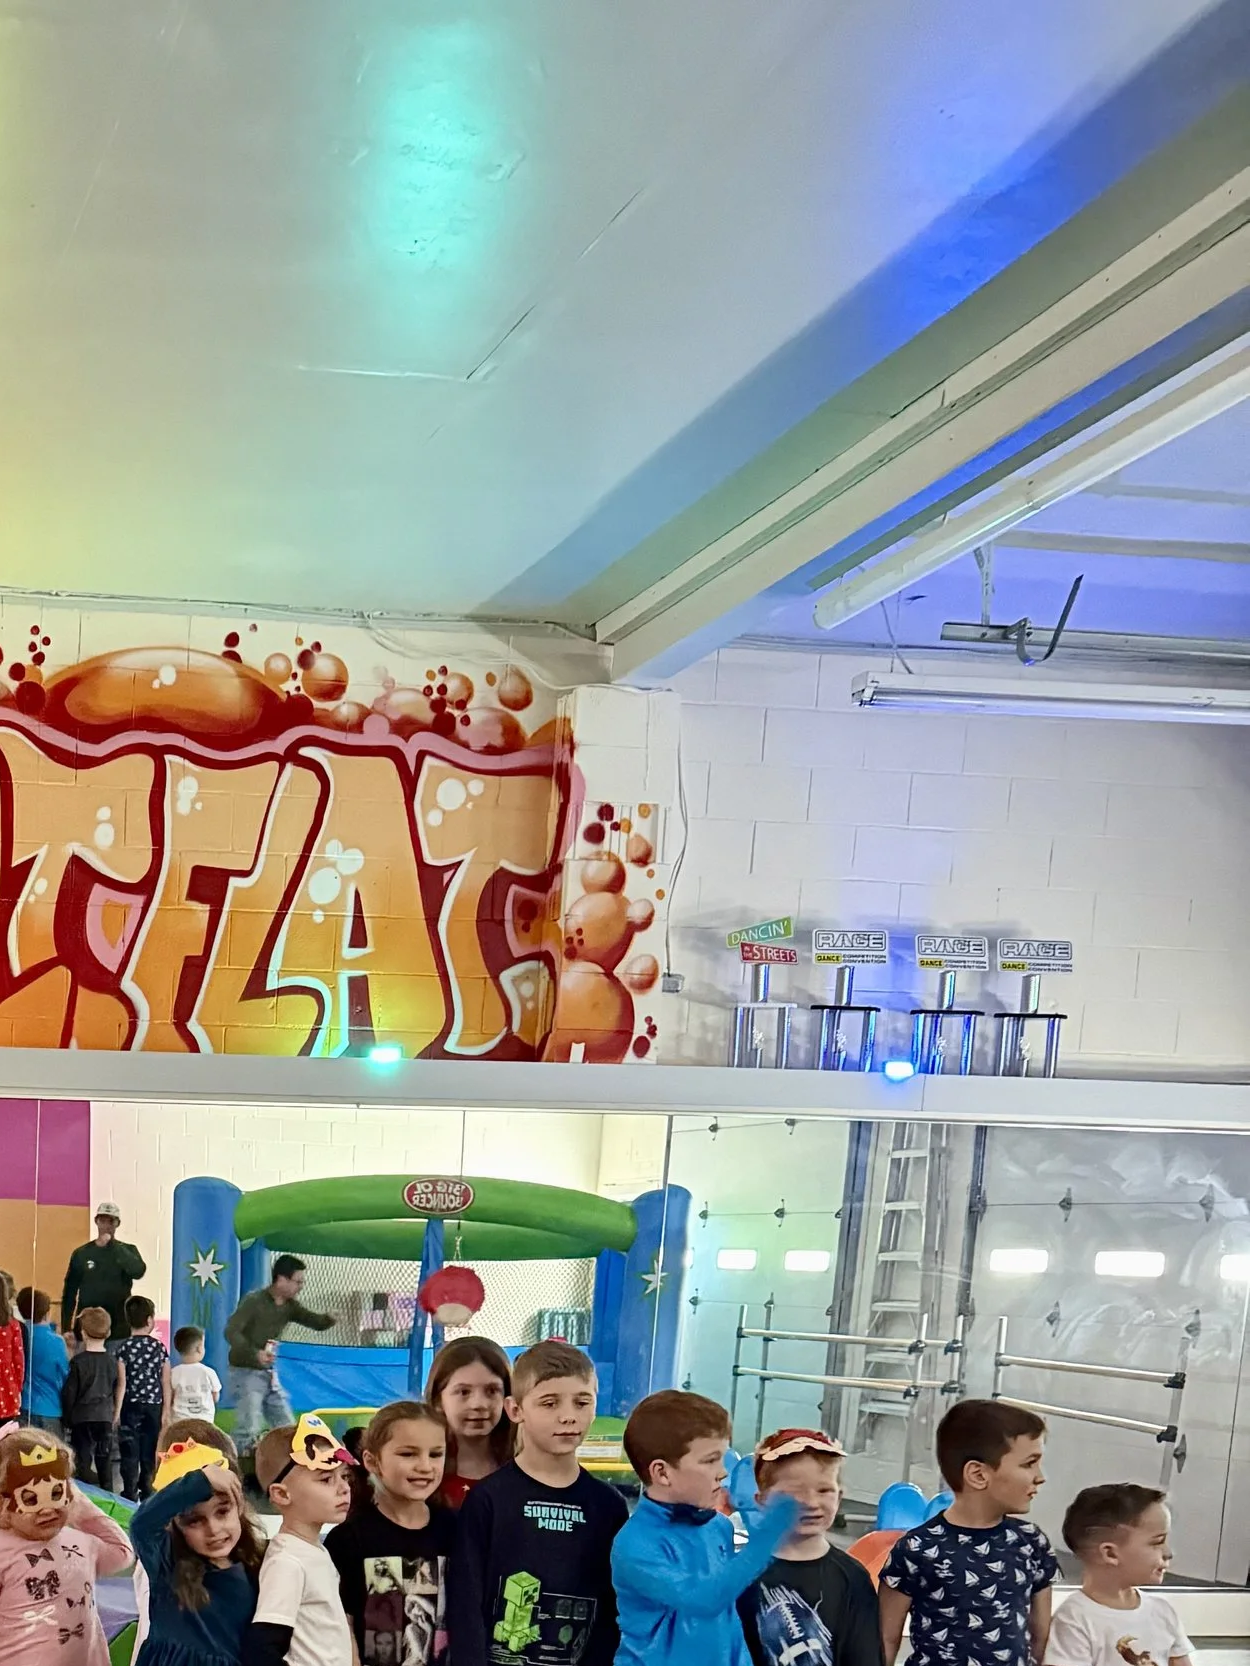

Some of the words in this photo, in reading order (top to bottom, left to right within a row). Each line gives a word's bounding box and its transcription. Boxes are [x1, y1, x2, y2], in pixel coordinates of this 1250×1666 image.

[731, 920, 788, 944] DANCIN'
[817, 933, 884, 949] RAGE
[921, 938, 983, 954] RAGE
[1002, 941, 1070, 957] RAGE
[752, 945, 797, 962] STREETS
[920, 959, 943, 967] DANCE
[523, 1505, 587, 1523] SURVIVAL
[538, 1518, 574, 1532] MODE
